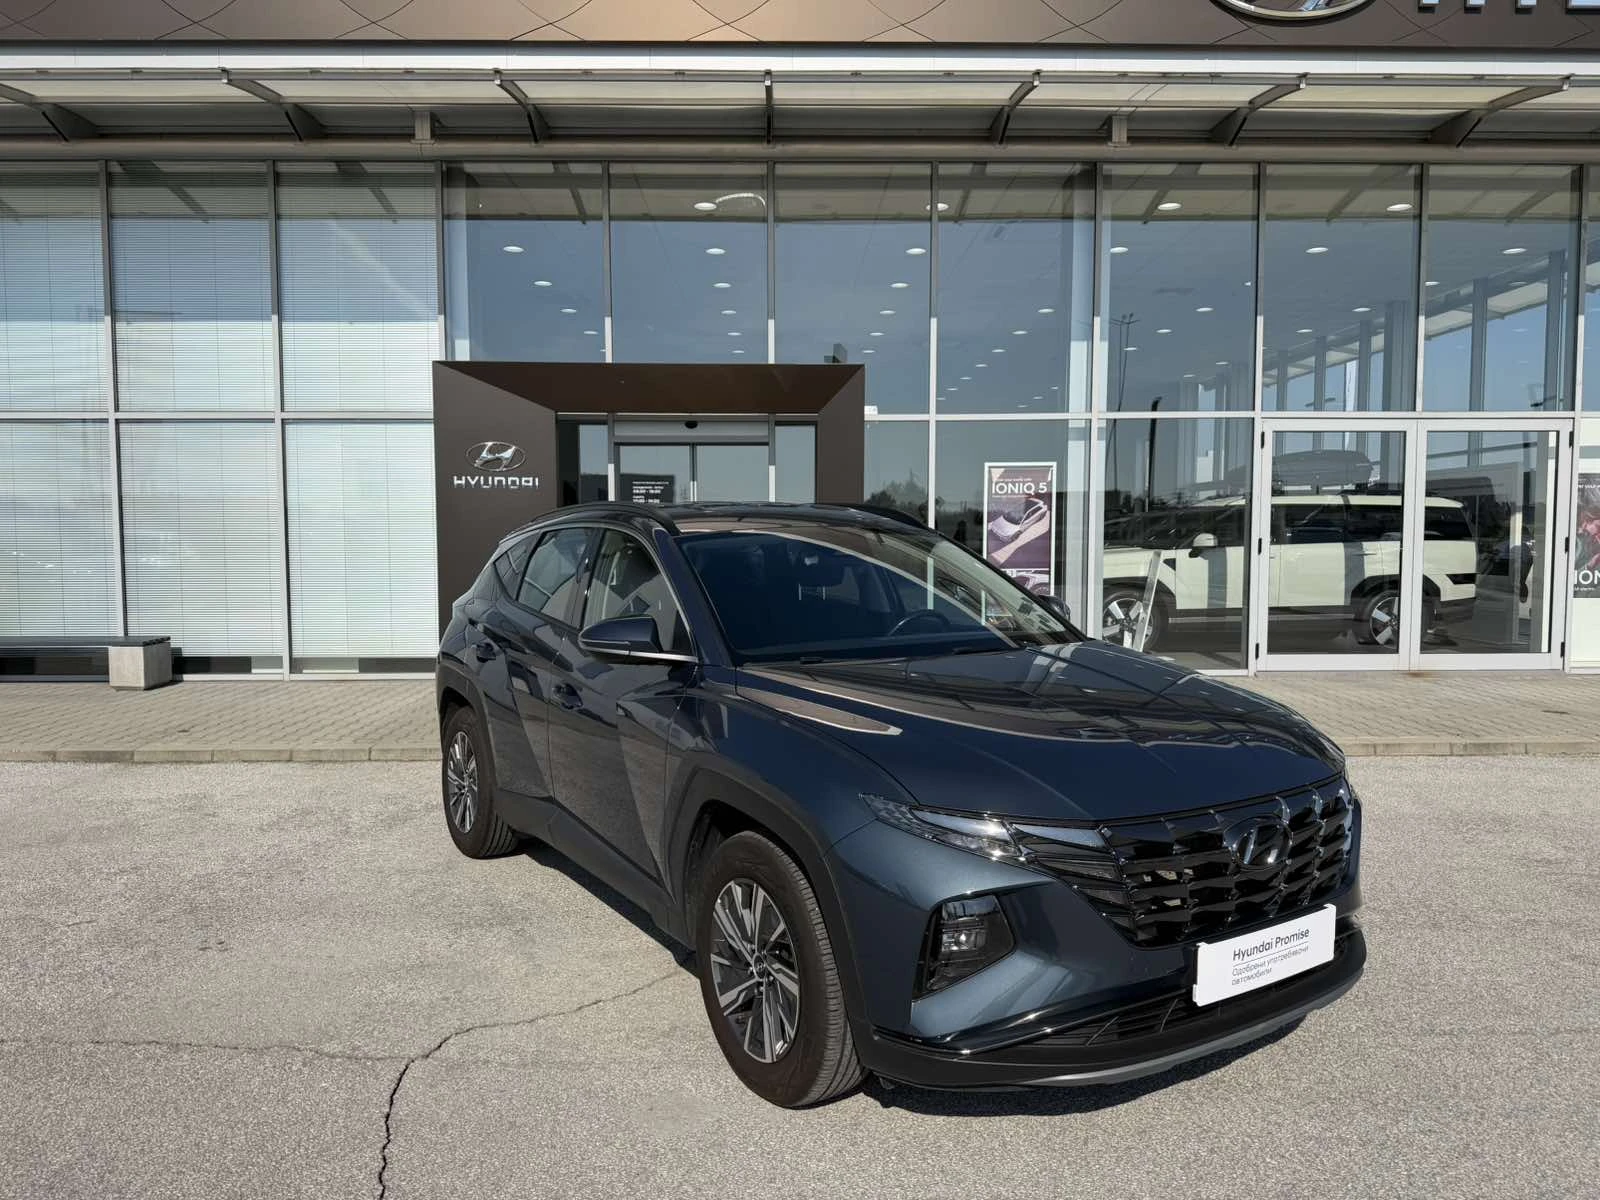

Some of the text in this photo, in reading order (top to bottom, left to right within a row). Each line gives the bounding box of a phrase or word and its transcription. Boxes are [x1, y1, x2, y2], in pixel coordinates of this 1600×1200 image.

[453, 475, 539, 489] HYUNDAI
[992, 482, 1048, 496] IONIQ 5
[1233, 928, 1310, 961] Hyundai Promise
[1232, 960, 1266, 977] Одобрени
[1232, 967, 1272, 985] автомобили
